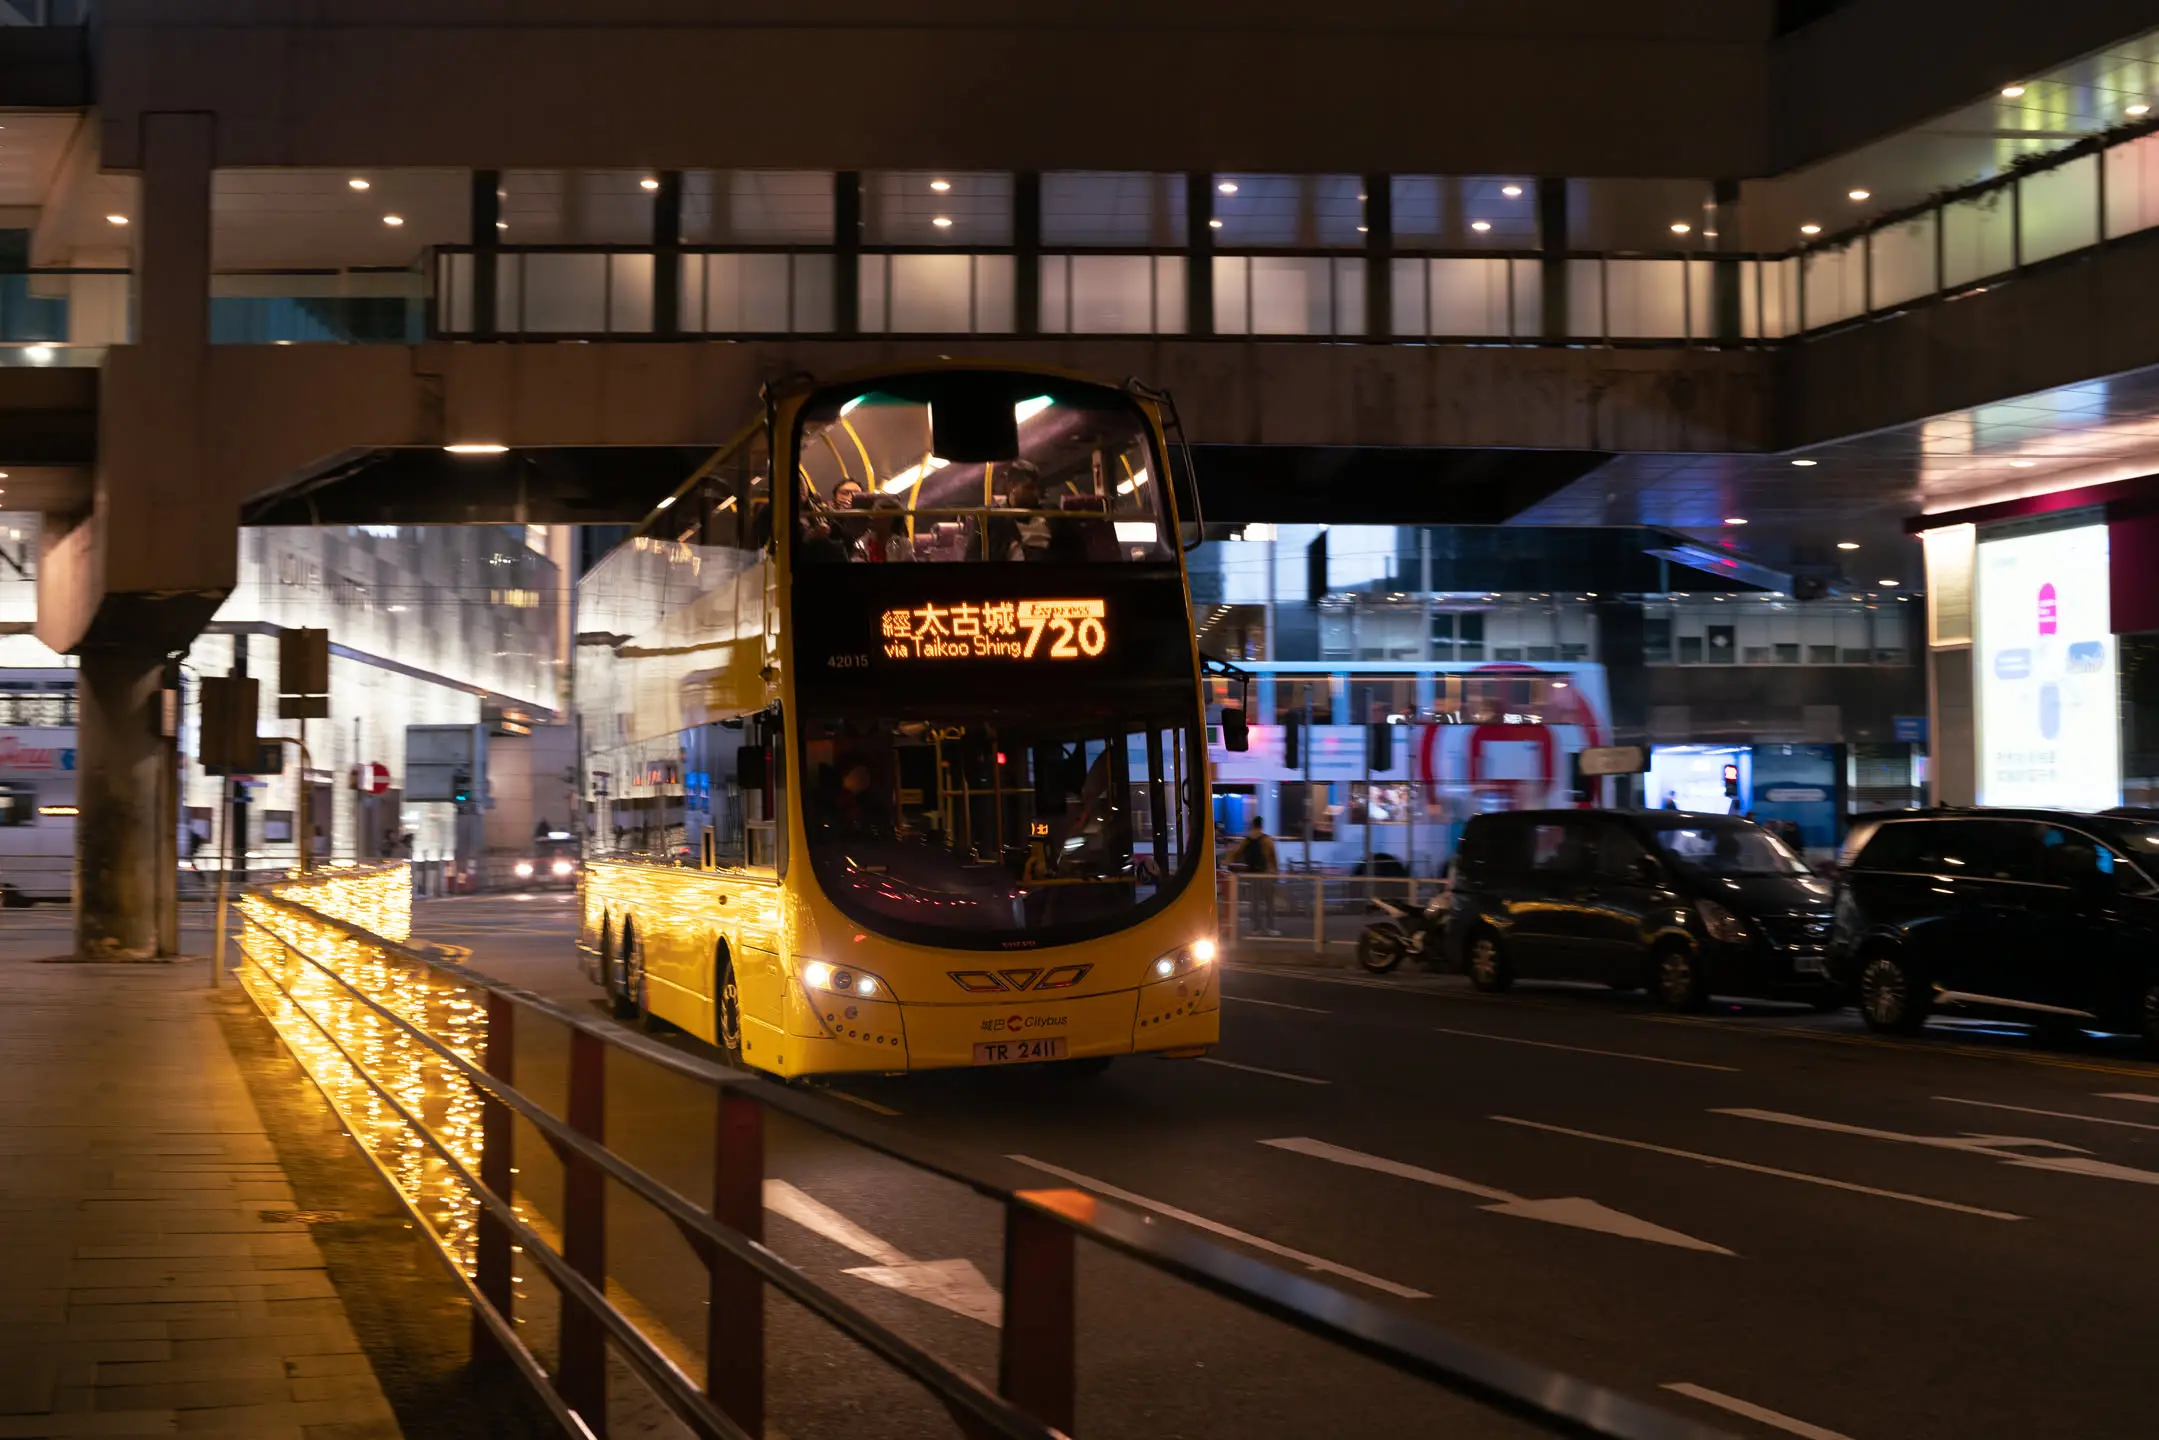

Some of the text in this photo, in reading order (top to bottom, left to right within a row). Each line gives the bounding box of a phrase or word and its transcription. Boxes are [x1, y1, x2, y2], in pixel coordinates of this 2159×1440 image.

[882, 602, 1016, 637] 經太古城
[1030, 604, 1090, 617] Express
[884, 635, 1021, 658] via Taikoo Shing
[1018, 618, 1105, 658] 720
[827, 655, 868, 668] 42015
[1024, 1016, 1067, 1028] Citybus
[984, 1041, 1055, 1061] TR 2411
